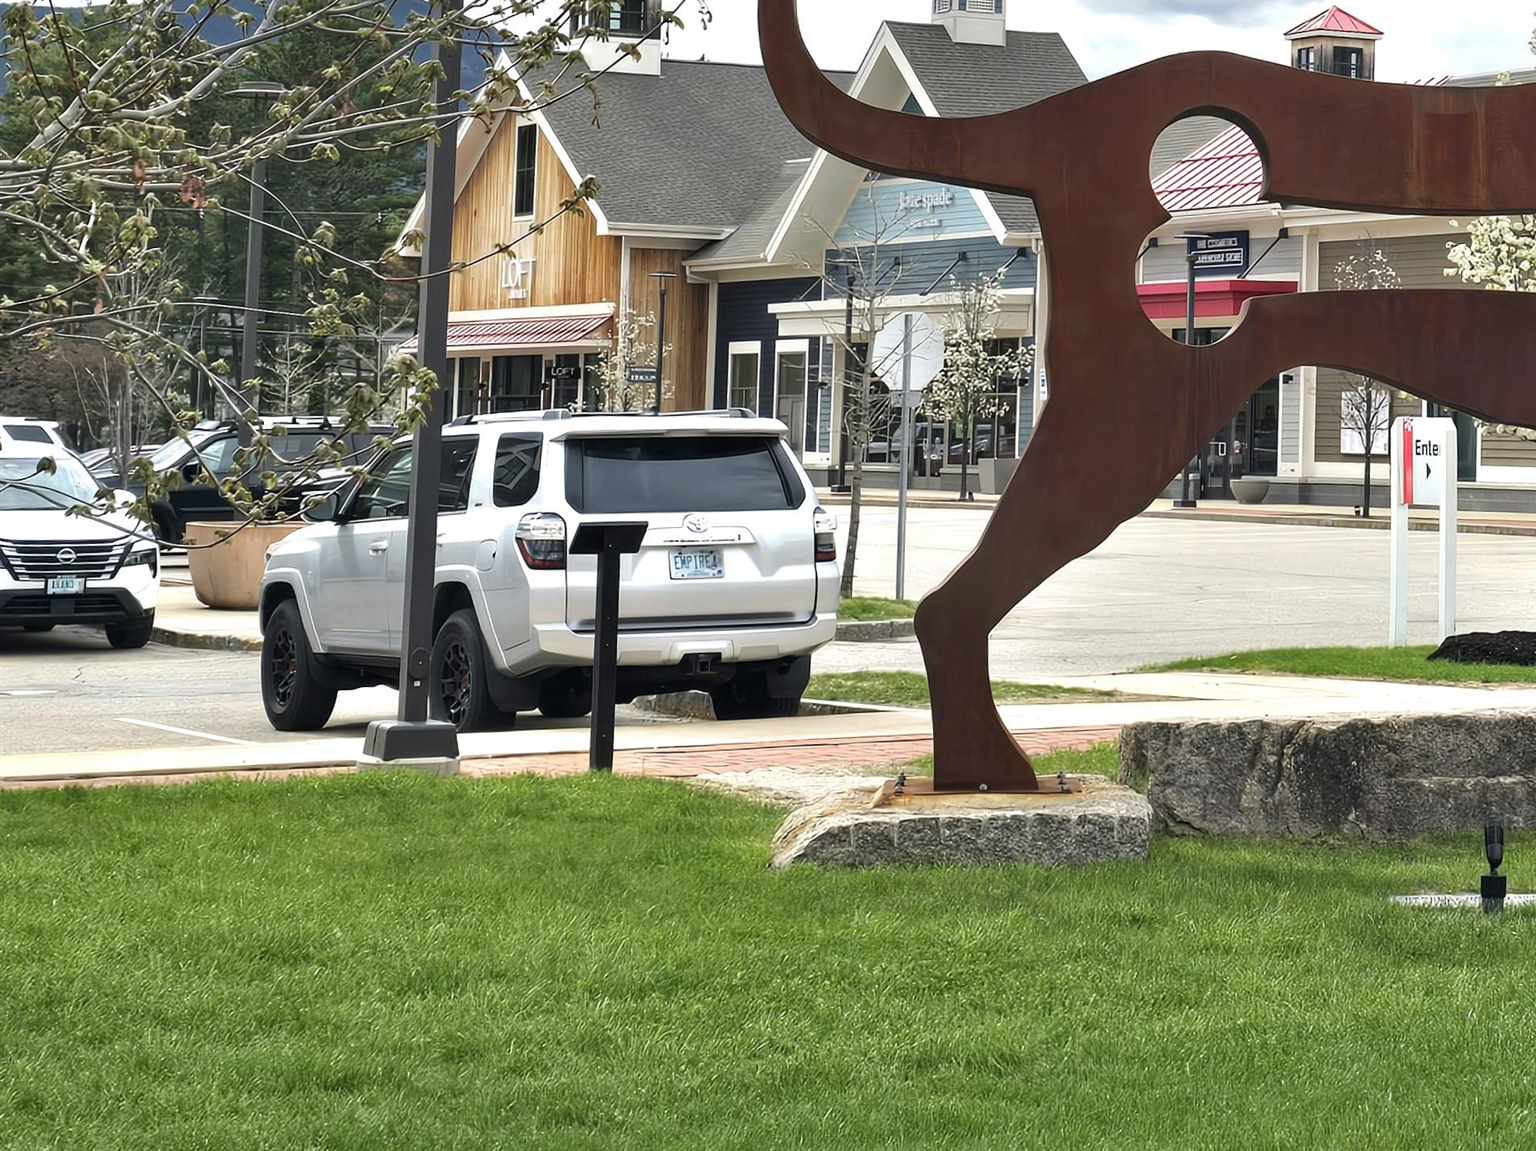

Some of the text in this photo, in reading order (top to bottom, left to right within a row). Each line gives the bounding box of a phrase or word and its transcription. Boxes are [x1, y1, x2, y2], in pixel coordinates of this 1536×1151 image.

[501, 257, 536, 288] LOFT
[551, 367, 575, 376] LOFT
[1415, 439, 1440, 456] Ente
